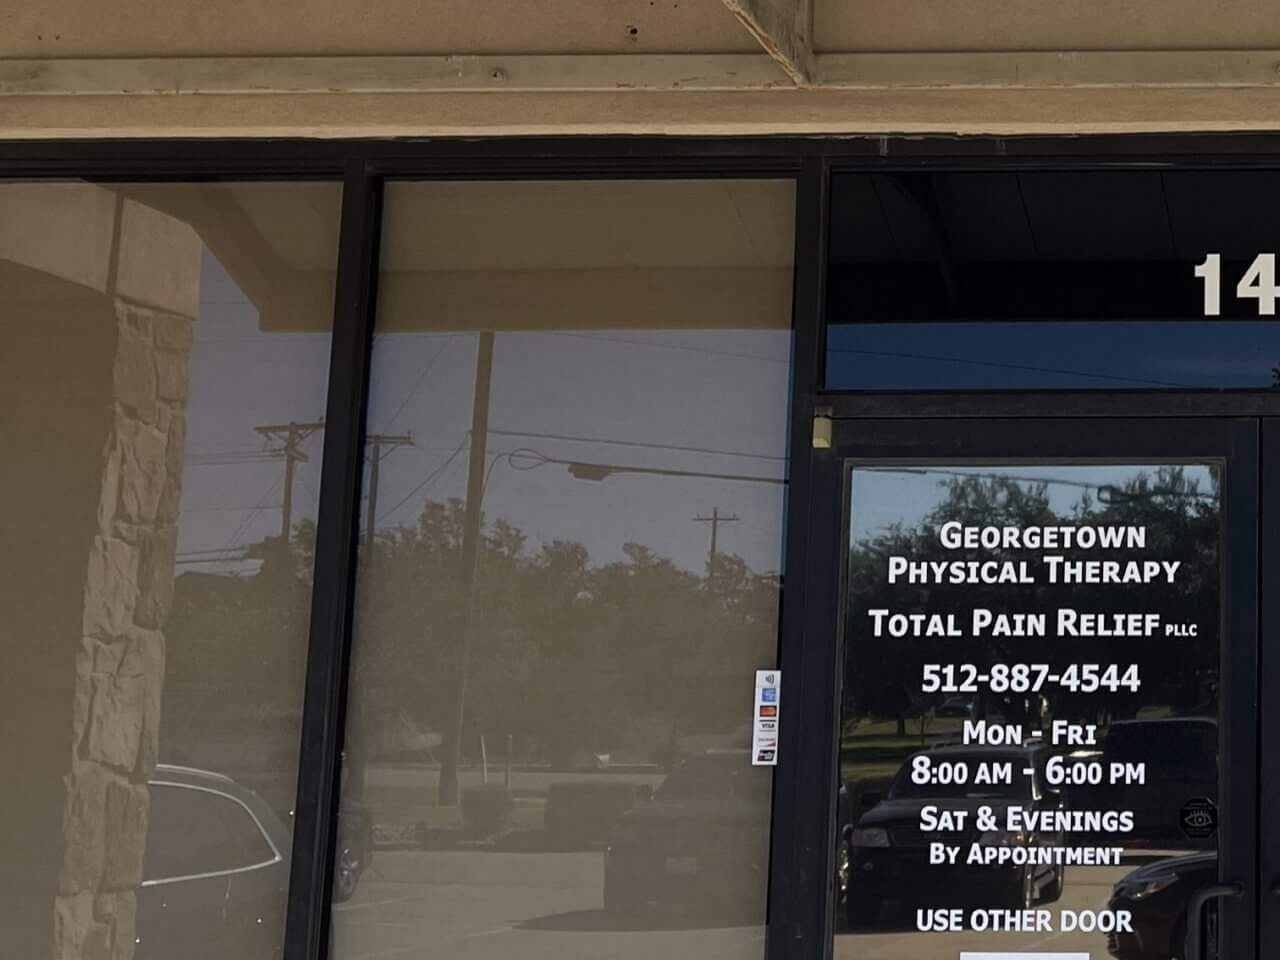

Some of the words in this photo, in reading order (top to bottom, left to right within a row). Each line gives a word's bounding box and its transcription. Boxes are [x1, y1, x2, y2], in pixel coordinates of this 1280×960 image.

[940, 521, 1146, 549] GEORGETOWN
[888, 556, 1035, 584] PHYSICAL
[1043, 555, 1181, 583] THERAPY
[868, 609, 962, 637] TOTAL
[972, 609, 1046, 636] PAIN
[1057, 608, 1160, 636] RELIEF
[1165, 624, 1197, 637] PLLC
[922, 663, 1141, 693] 512-887-4544
[963, 720, 1022, 745] MON
[1052, 719, 1097, 745] FRI
[911, 755, 968, 785] 8:00
[974, 762, 1012, 784] AM
[1045, 753, 1102, 785] 6:00
[1110, 762, 1145, 785] PM
[919, 805, 968, 831] SAT
[976, 805, 999, 832] &
[1006, 804, 1134, 832] EVENINGS
[930, 842, 961, 865] BY
[966, 842, 1124, 865] APPOINTMENT
[916, 909, 964, 932] USE
[970, 909, 1054, 932] OTHER
[1060, 909, 1133, 933] DOOR
